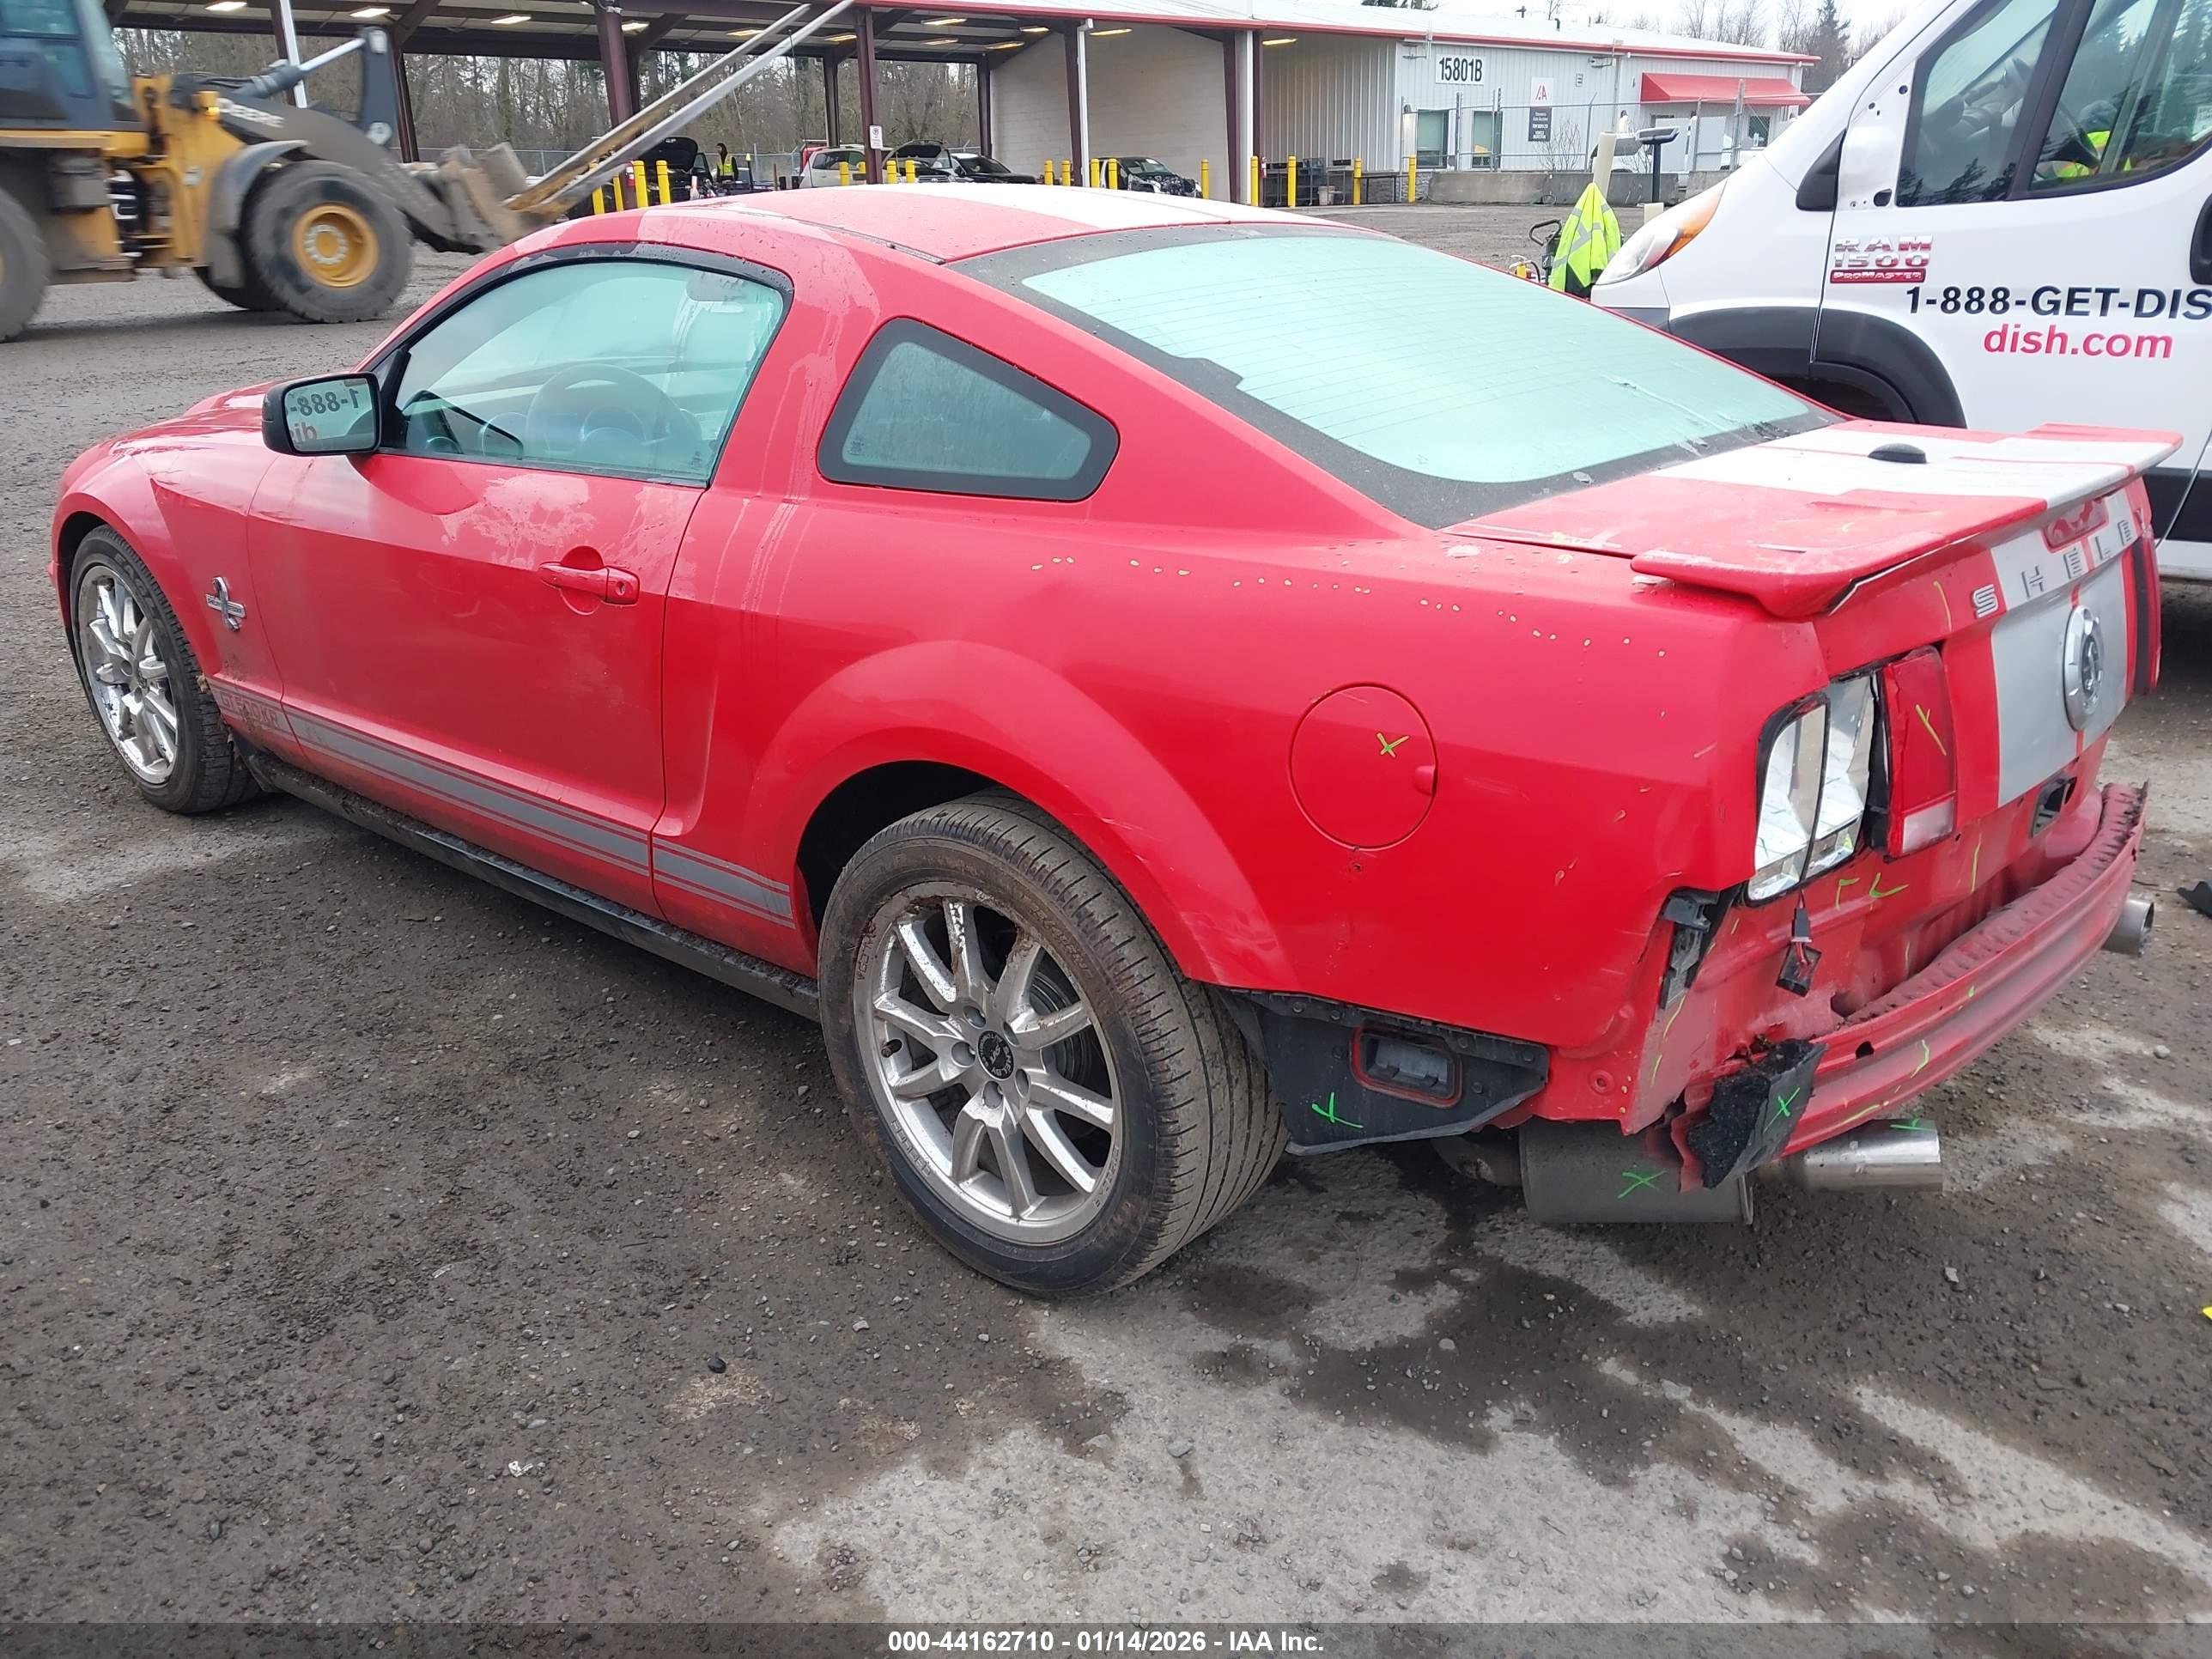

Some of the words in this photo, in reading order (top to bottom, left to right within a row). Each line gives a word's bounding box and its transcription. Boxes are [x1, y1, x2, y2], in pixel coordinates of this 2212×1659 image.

[1438, 57, 1482, 82] 15801B
[218, 98, 285, 129] DEERE
[1834, 235, 1932, 252] RAM
[1834, 253, 1929, 267] 1500
[1906, 285, 2212, 320] 1-888-GET-DIS
[1984, 323, 2172, 358] dish.com
